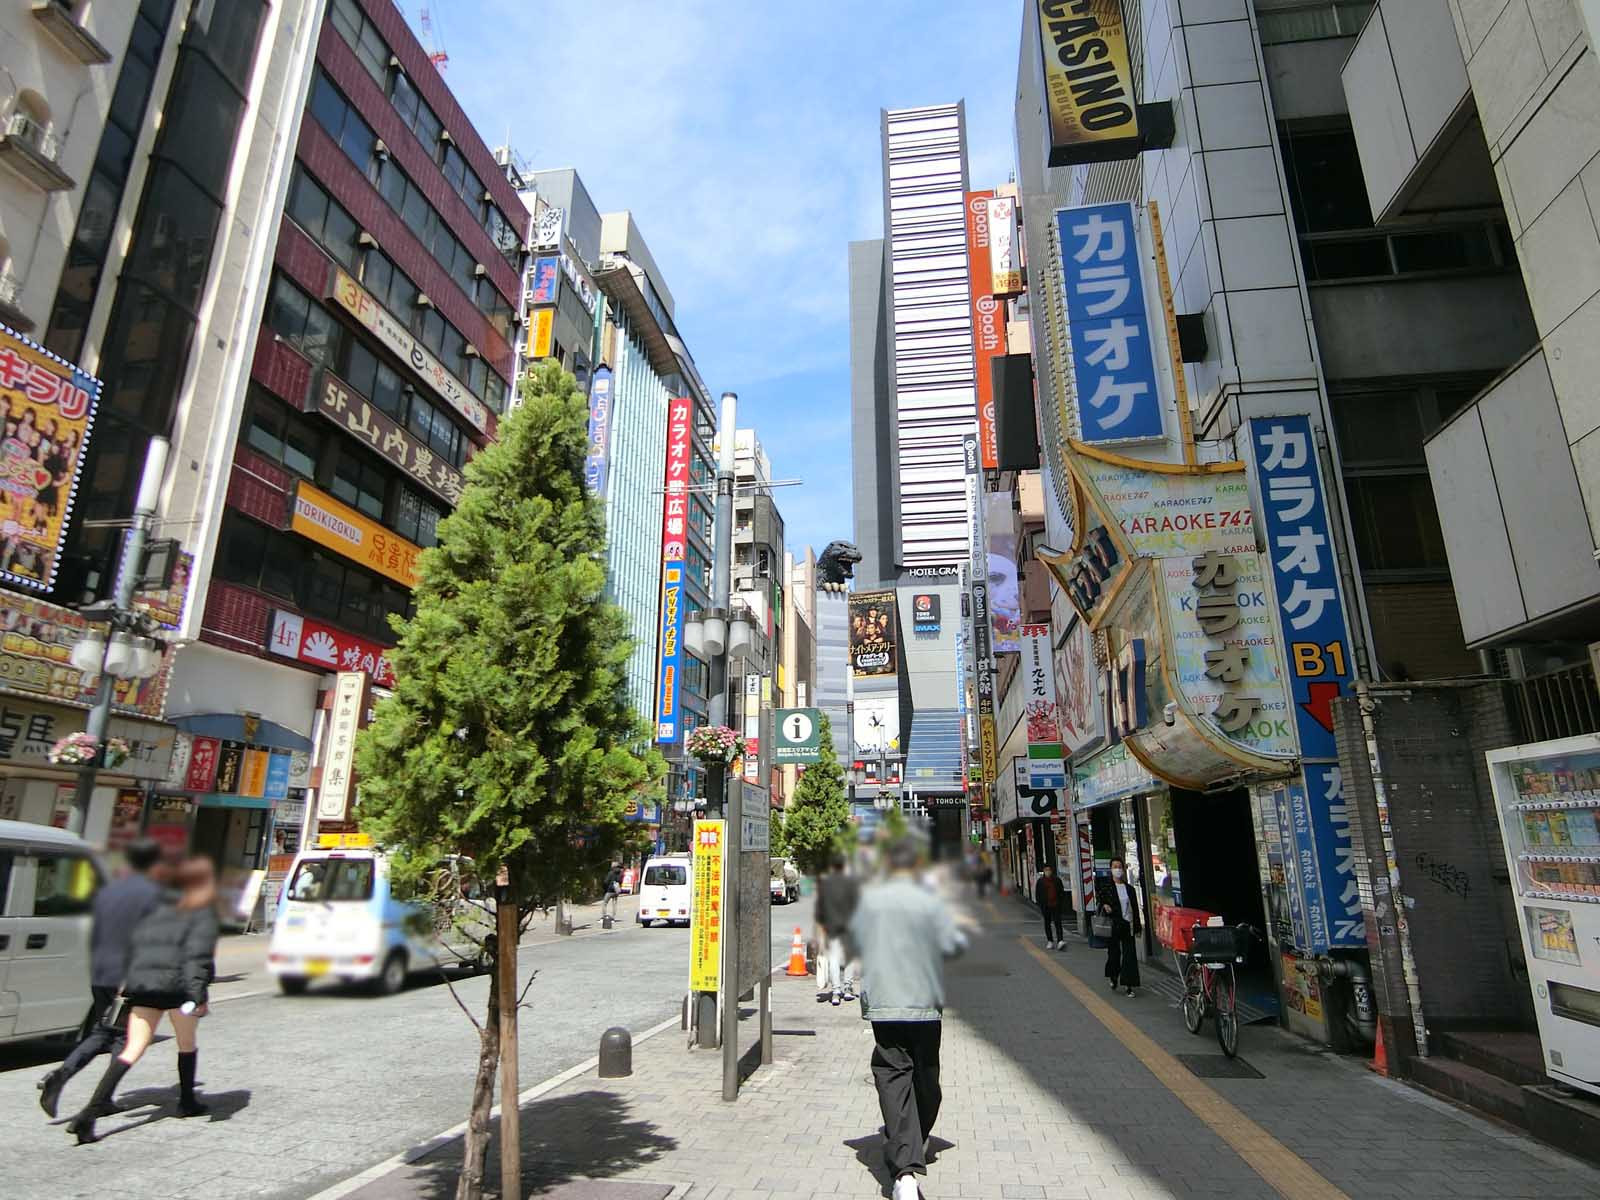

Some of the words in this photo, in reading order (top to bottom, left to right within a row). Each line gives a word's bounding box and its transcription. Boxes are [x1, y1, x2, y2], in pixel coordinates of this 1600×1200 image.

[344, 282, 369, 313] 3F
[976, 295, 999, 351] Booth
[1072, 214, 1148, 430] カラオケ
[324, 382, 348, 412] 5F
[1154, 496, 1213, 508] KARAOKE747
[298, 500, 356, 540] TORIKIZOKU
[1119, 509, 1252, 535] KARAOKE747
[1259, 425, 1336, 630] カラオケ
[909, 567, 938, 577] HOTEL
[273, 621, 298, 649] 4F
[1191, 550, 1261, 733] カラオケ
[1291, 640, 1348, 678] B1
[977, 658, 992, 694] 甘太郎
[1032, 668, 1046, 696] 九十九
[1031, 761, 1062, 770] FamilyMart
